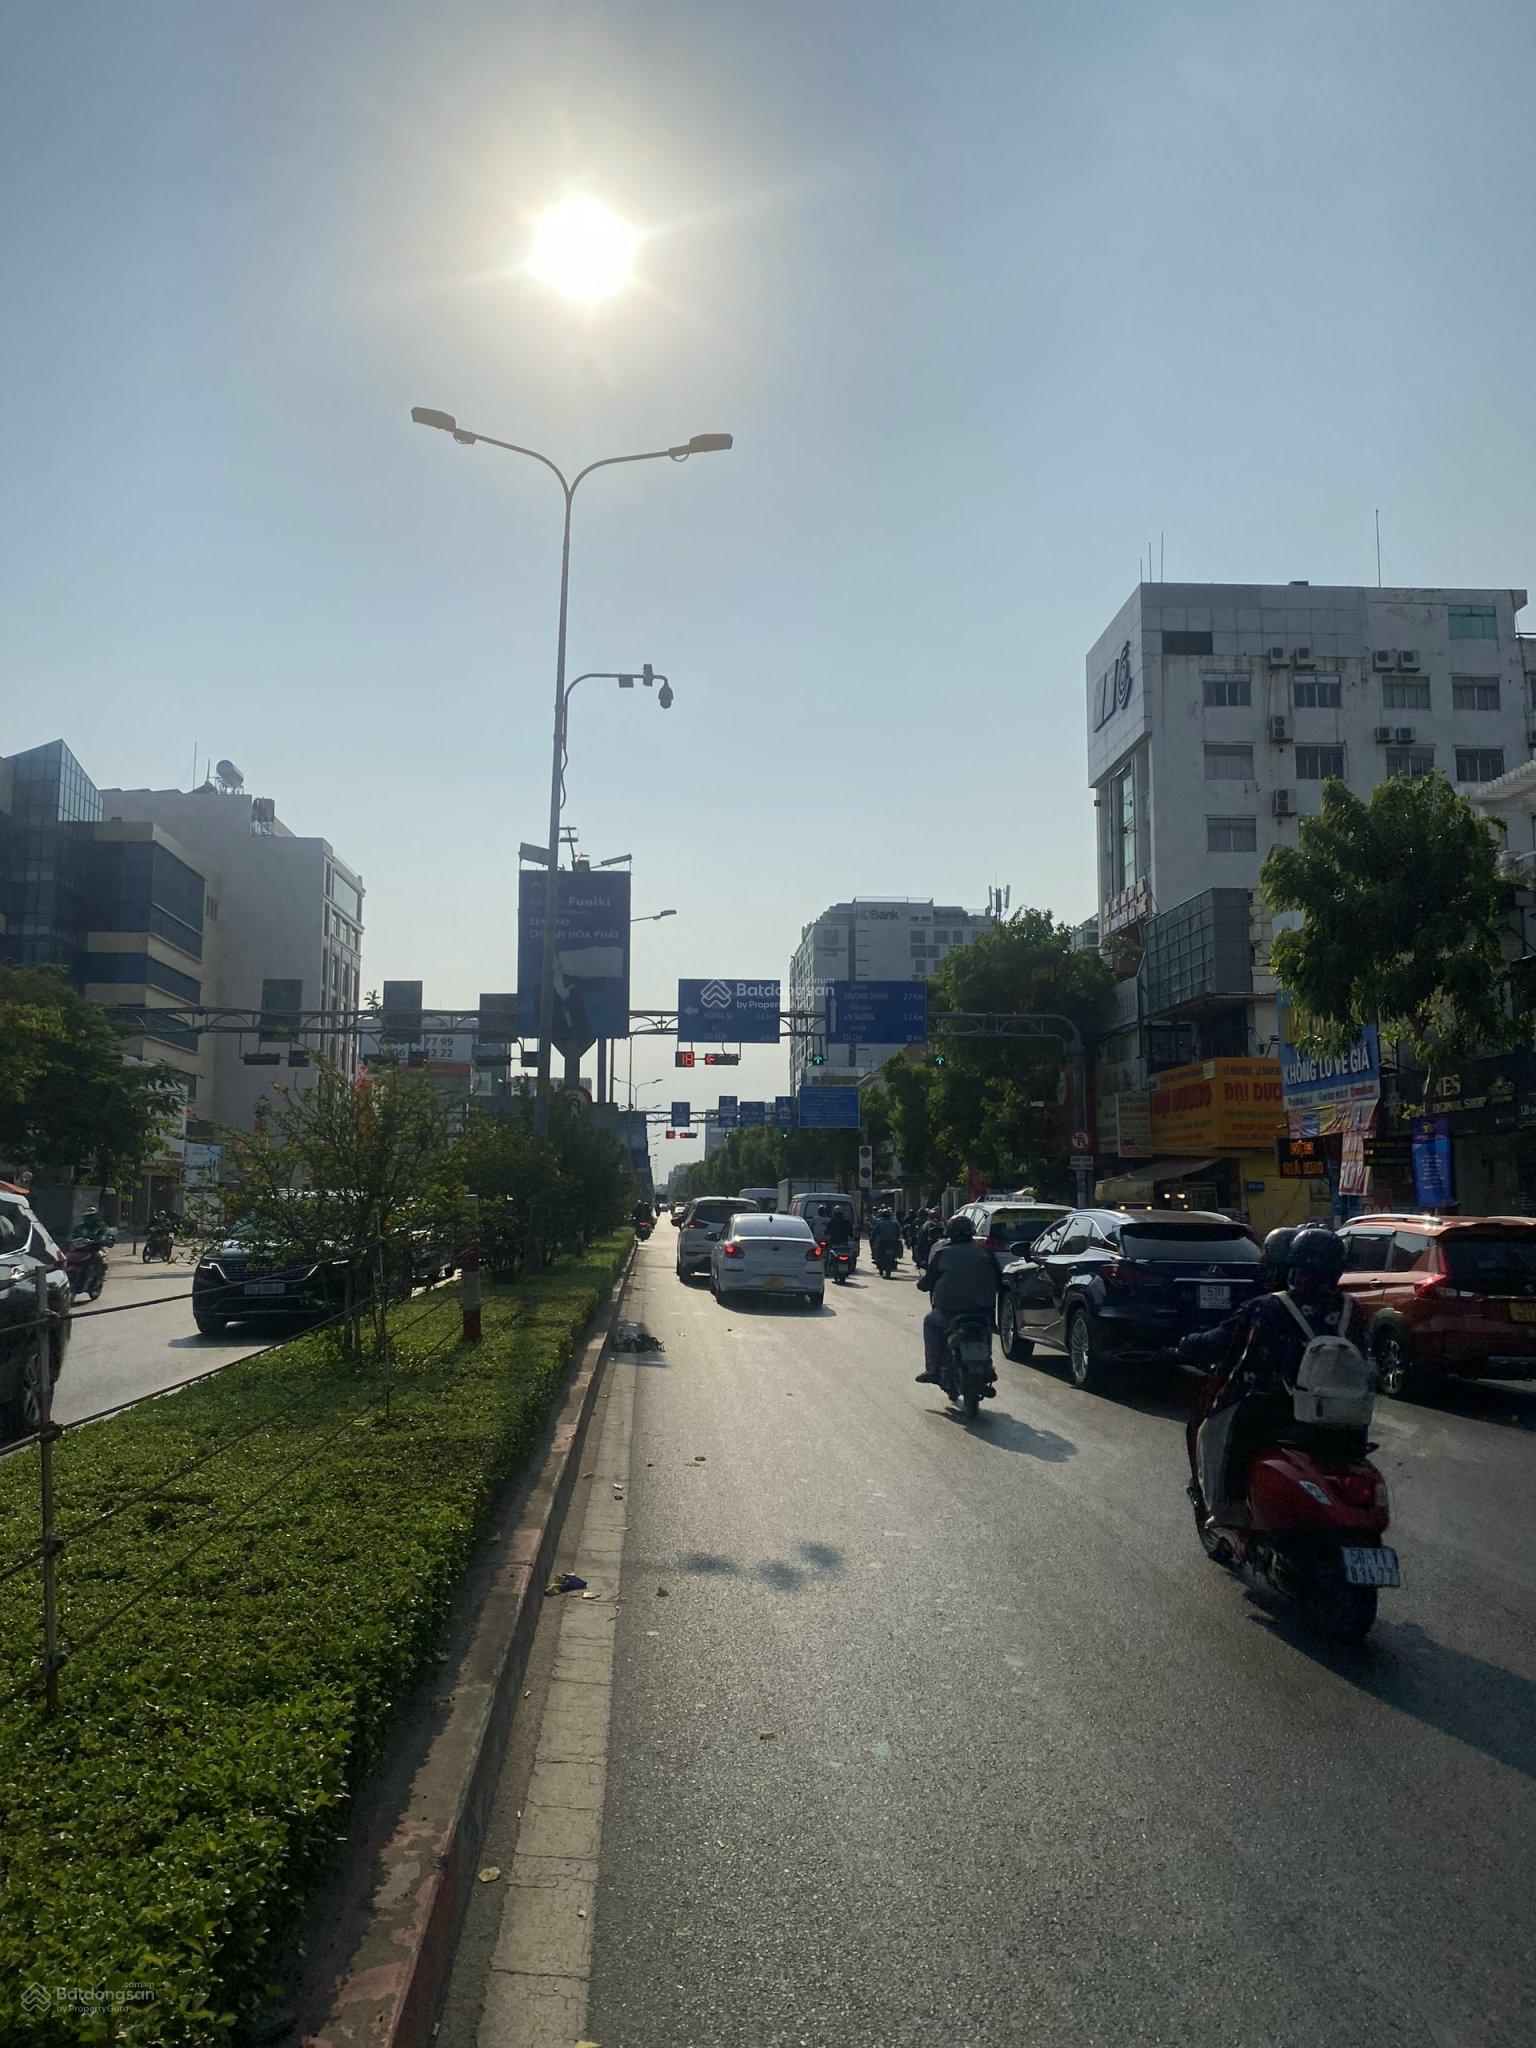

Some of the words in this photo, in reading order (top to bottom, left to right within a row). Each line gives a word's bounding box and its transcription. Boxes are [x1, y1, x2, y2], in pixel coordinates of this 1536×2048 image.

[568, 896, 611, 907] Funiki
[856, 909, 899, 920] HDBank
[440, 1037, 453, 1046] 99
[440, 1049, 453, 1057] 22
[1350, 1040, 1370, 1073] GIÁ
[1224, 1082, 1248, 1104] ĐẠI
